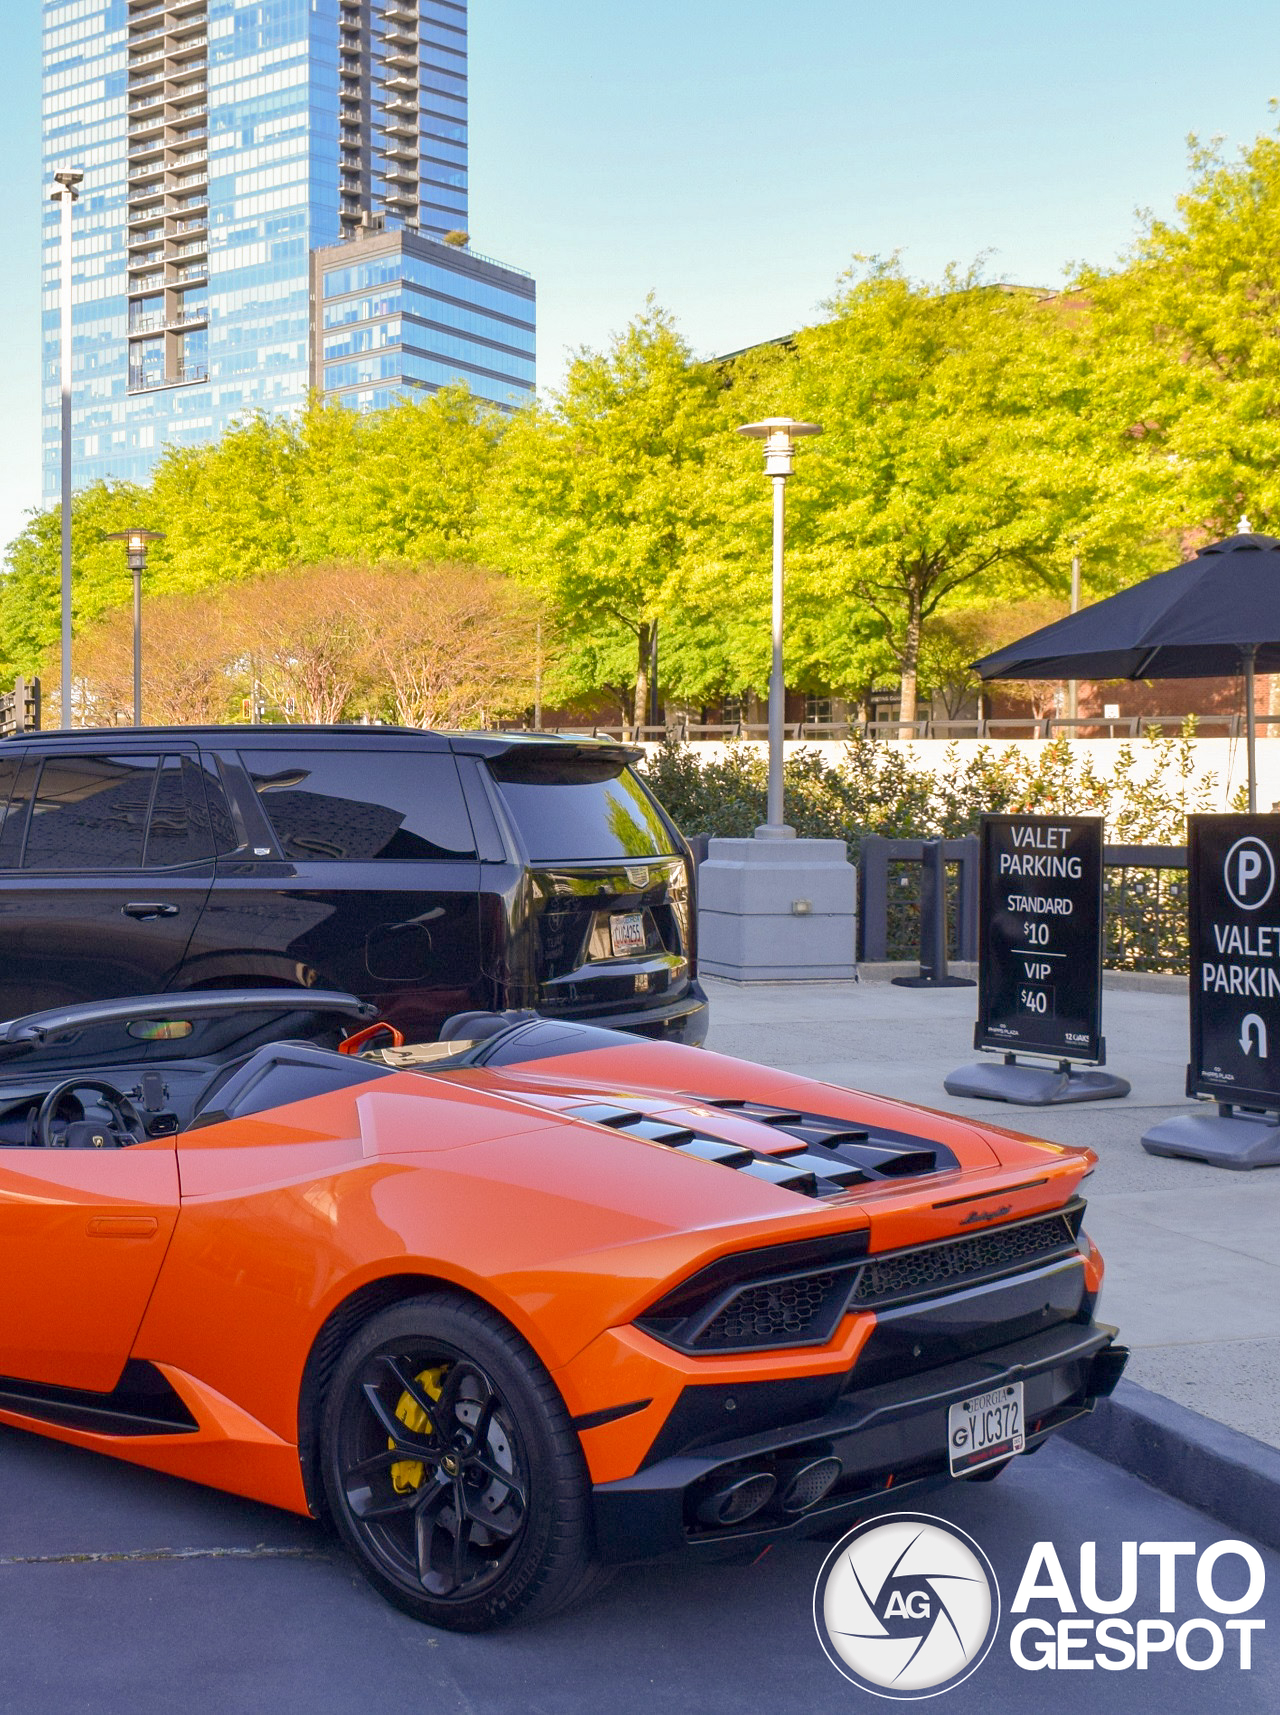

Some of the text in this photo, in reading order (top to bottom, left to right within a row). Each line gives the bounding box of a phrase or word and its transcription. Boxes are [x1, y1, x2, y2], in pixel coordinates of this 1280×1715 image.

[1011, 826, 1071, 849] VALET
[1000, 853, 1082, 879] PARKING
[1238, 850, 1263, 896] P
[1007, 894, 1073, 915] STANDARD
[1023, 921, 1049, 945] $10
[1024, 962, 1051, 980] VIP
[1021, 989, 1047, 1014] $40
[967, 1389, 1007, 1413] GEORGIA
